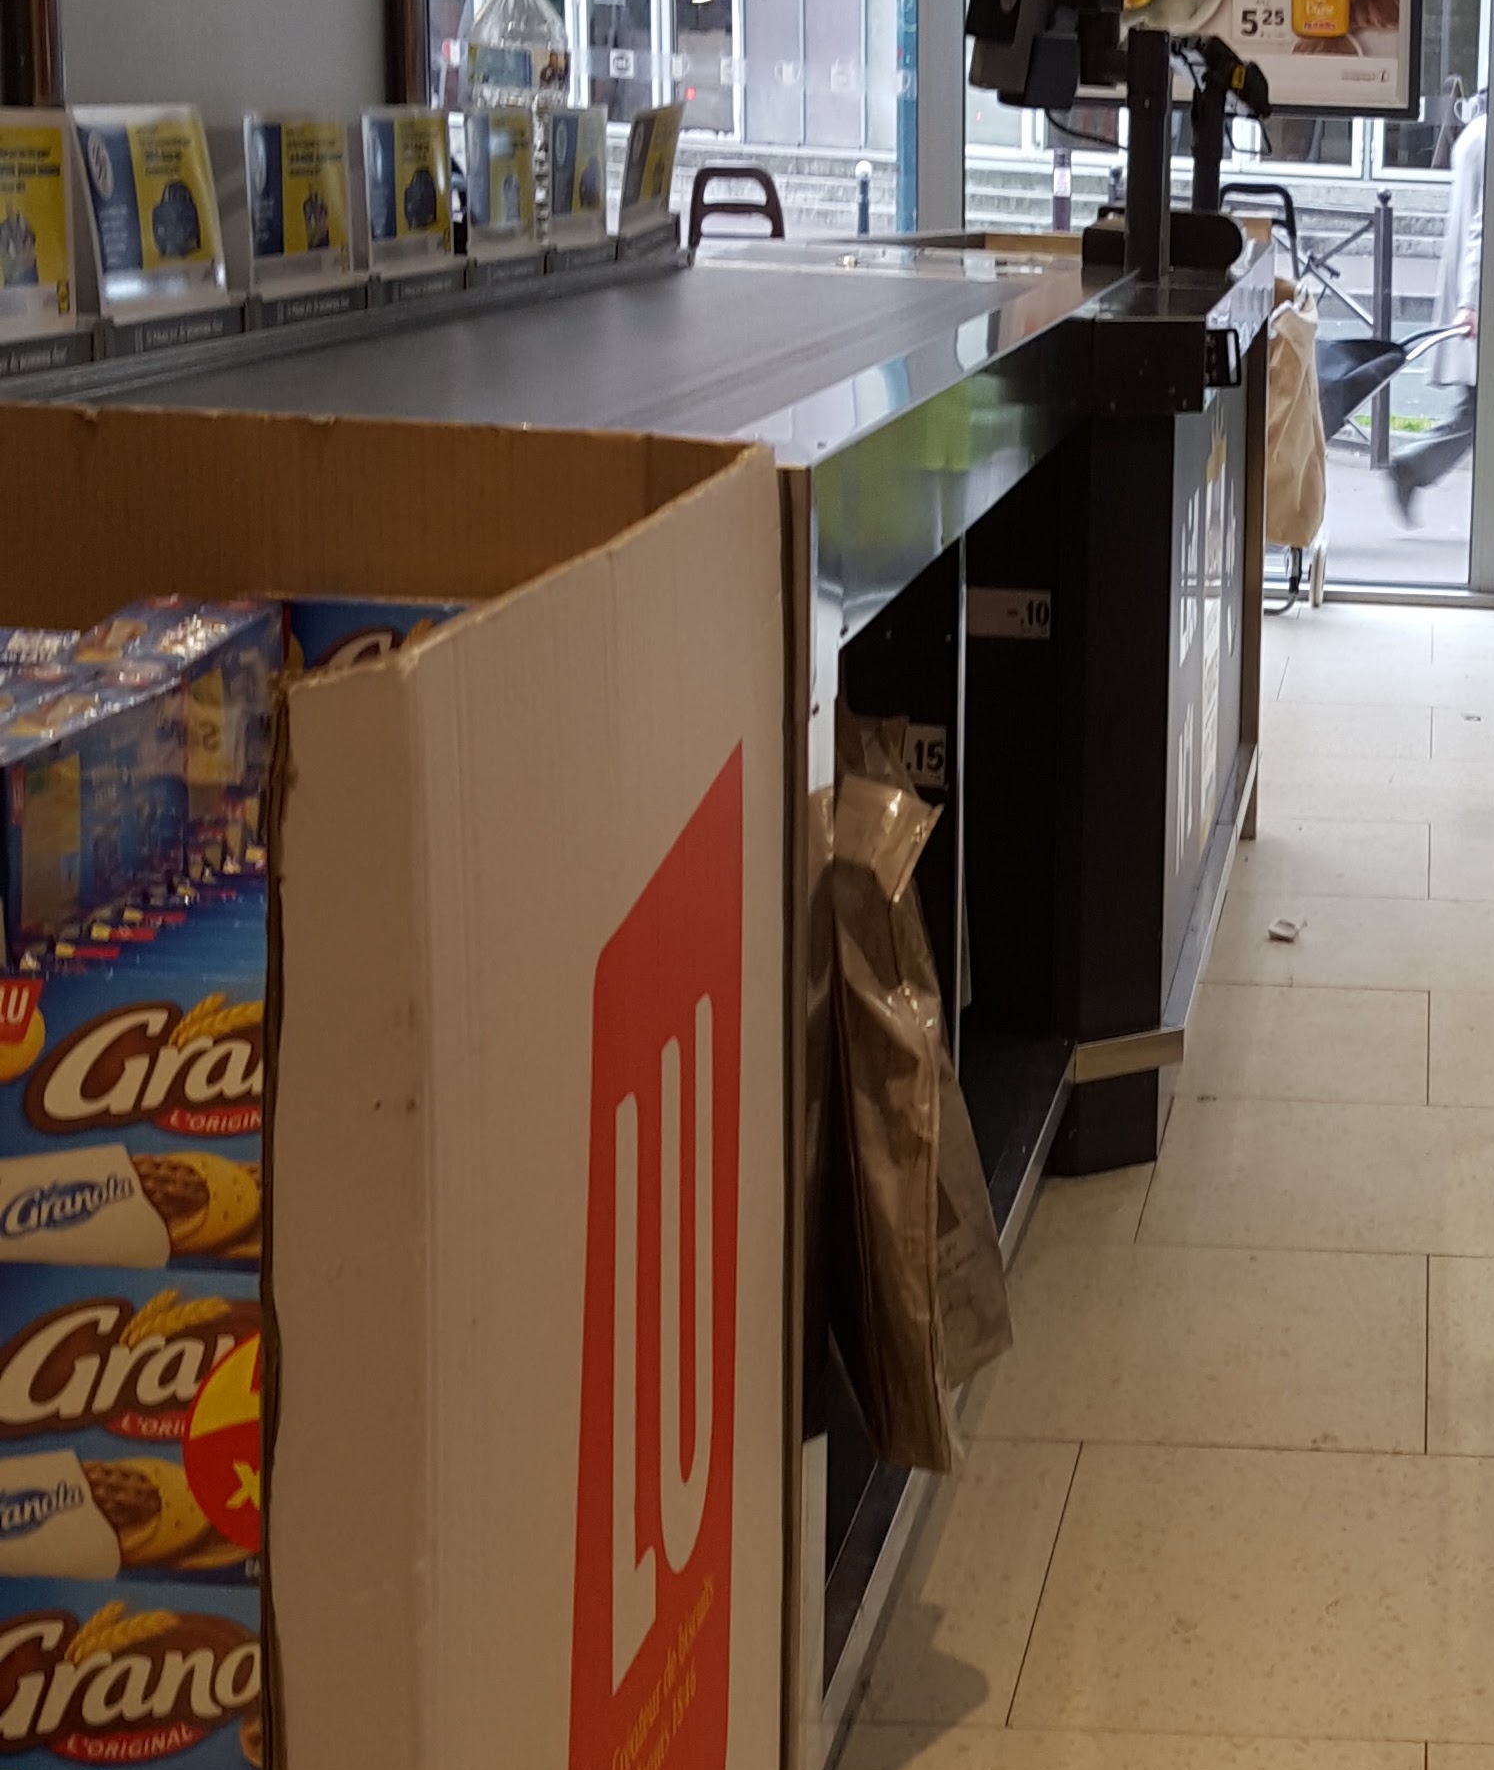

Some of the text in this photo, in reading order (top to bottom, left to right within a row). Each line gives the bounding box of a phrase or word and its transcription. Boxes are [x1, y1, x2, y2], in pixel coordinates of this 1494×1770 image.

[170, 1106, 261, 1133] L'ORIGIN
[2, 1169, 135, 1241] Granola
[612, 991, 716, 1696] LU
[0, 1619, 261, 1741] Grano
[67, 1723, 193, 1756] L'ORIGINAL
